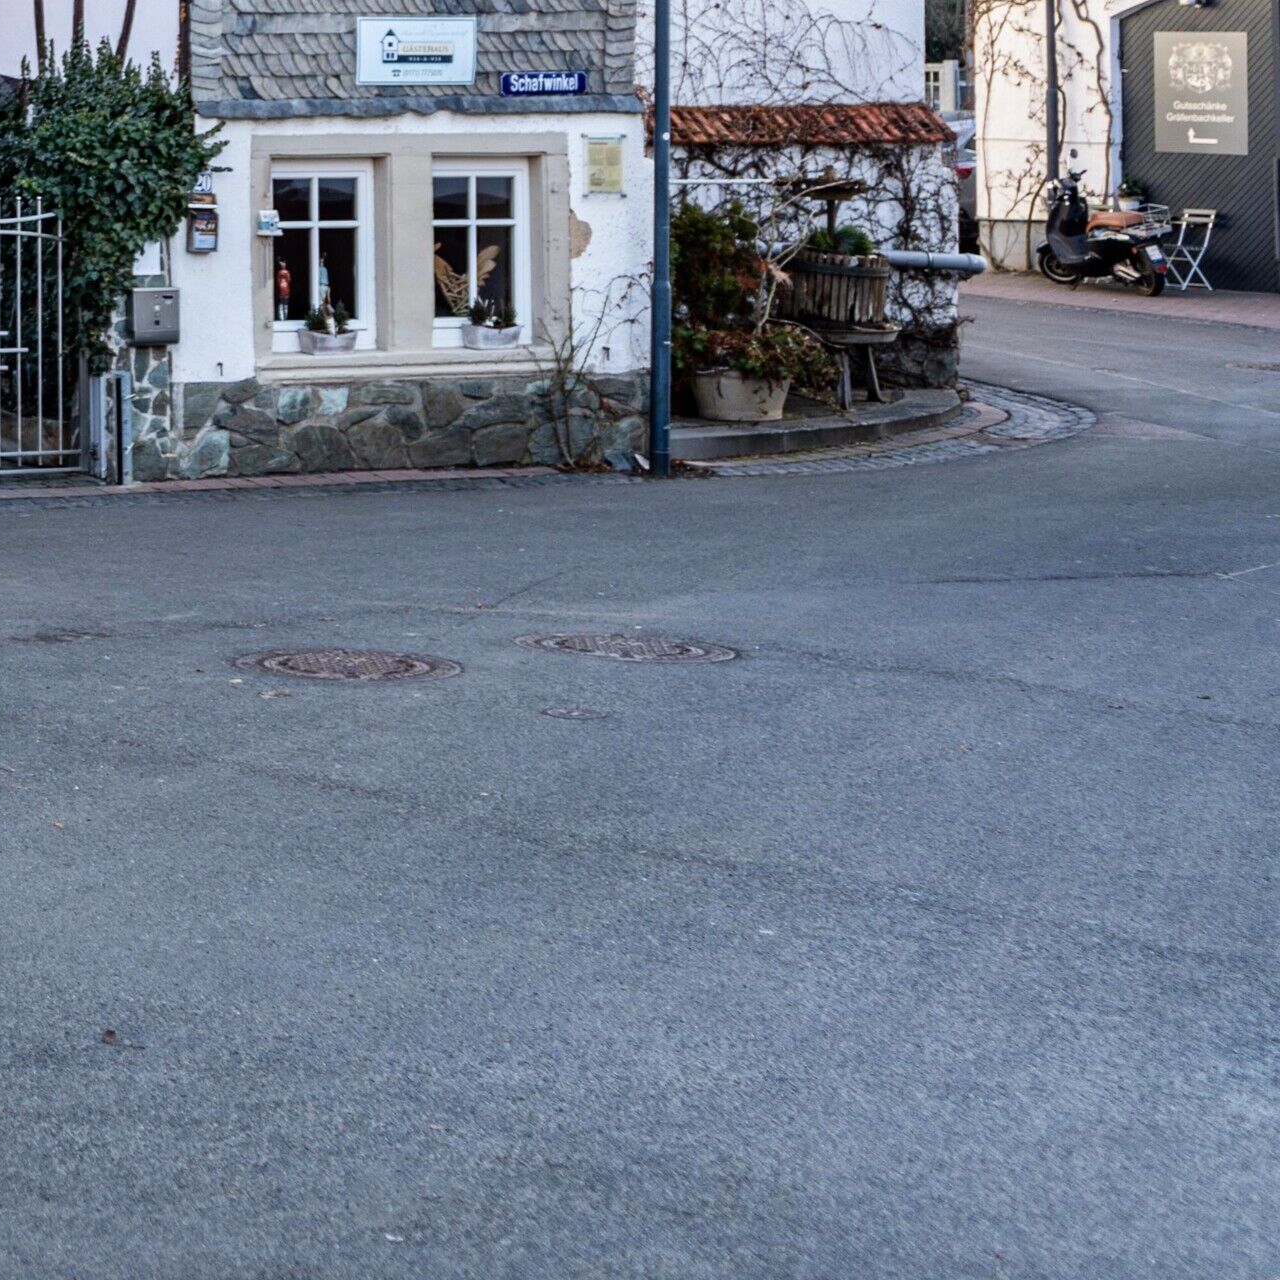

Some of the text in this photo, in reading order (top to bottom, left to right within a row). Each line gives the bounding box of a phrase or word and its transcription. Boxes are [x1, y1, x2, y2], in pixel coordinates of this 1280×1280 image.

[510, 73, 579, 93] Schafwinkel
[1172, 100, 1228, 111] Gutsschänke
[193, 174, 211, 192] 20
